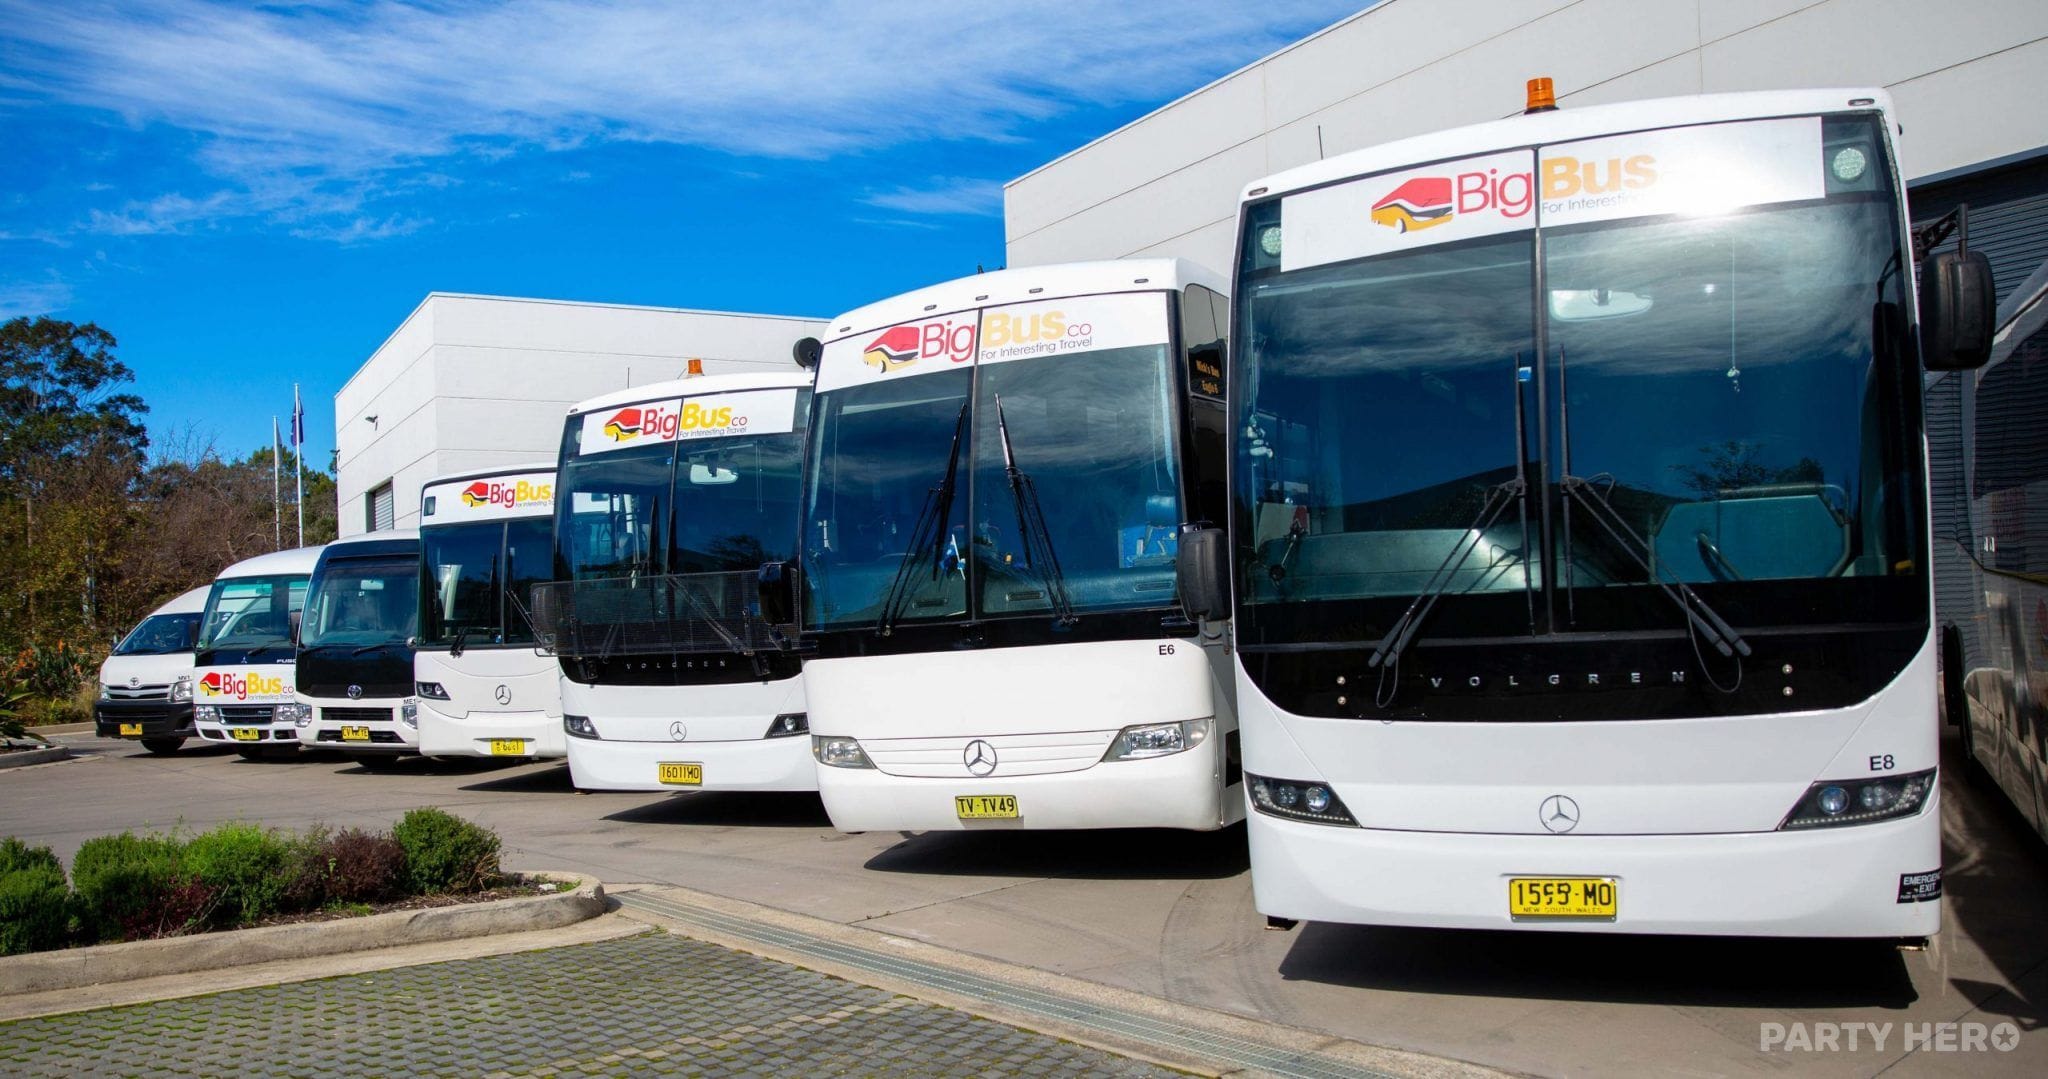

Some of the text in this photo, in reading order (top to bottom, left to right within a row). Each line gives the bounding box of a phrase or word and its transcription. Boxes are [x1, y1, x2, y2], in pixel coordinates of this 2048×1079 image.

[1541, 202, 1564, 214] For
[981, 337, 1093, 360] For Interesting Travel
[690, 428, 725, 438] Interesting
[726, 426, 747, 434] Travel
[1159, 644, 1175, 656] E6
[626, 660, 726, 670] VOLGREN
[1431, 671, 1685, 688] VOLGREN
[1869, 754, 1895, 771] E8
[1919, 882, 1937, 893] EXIT
